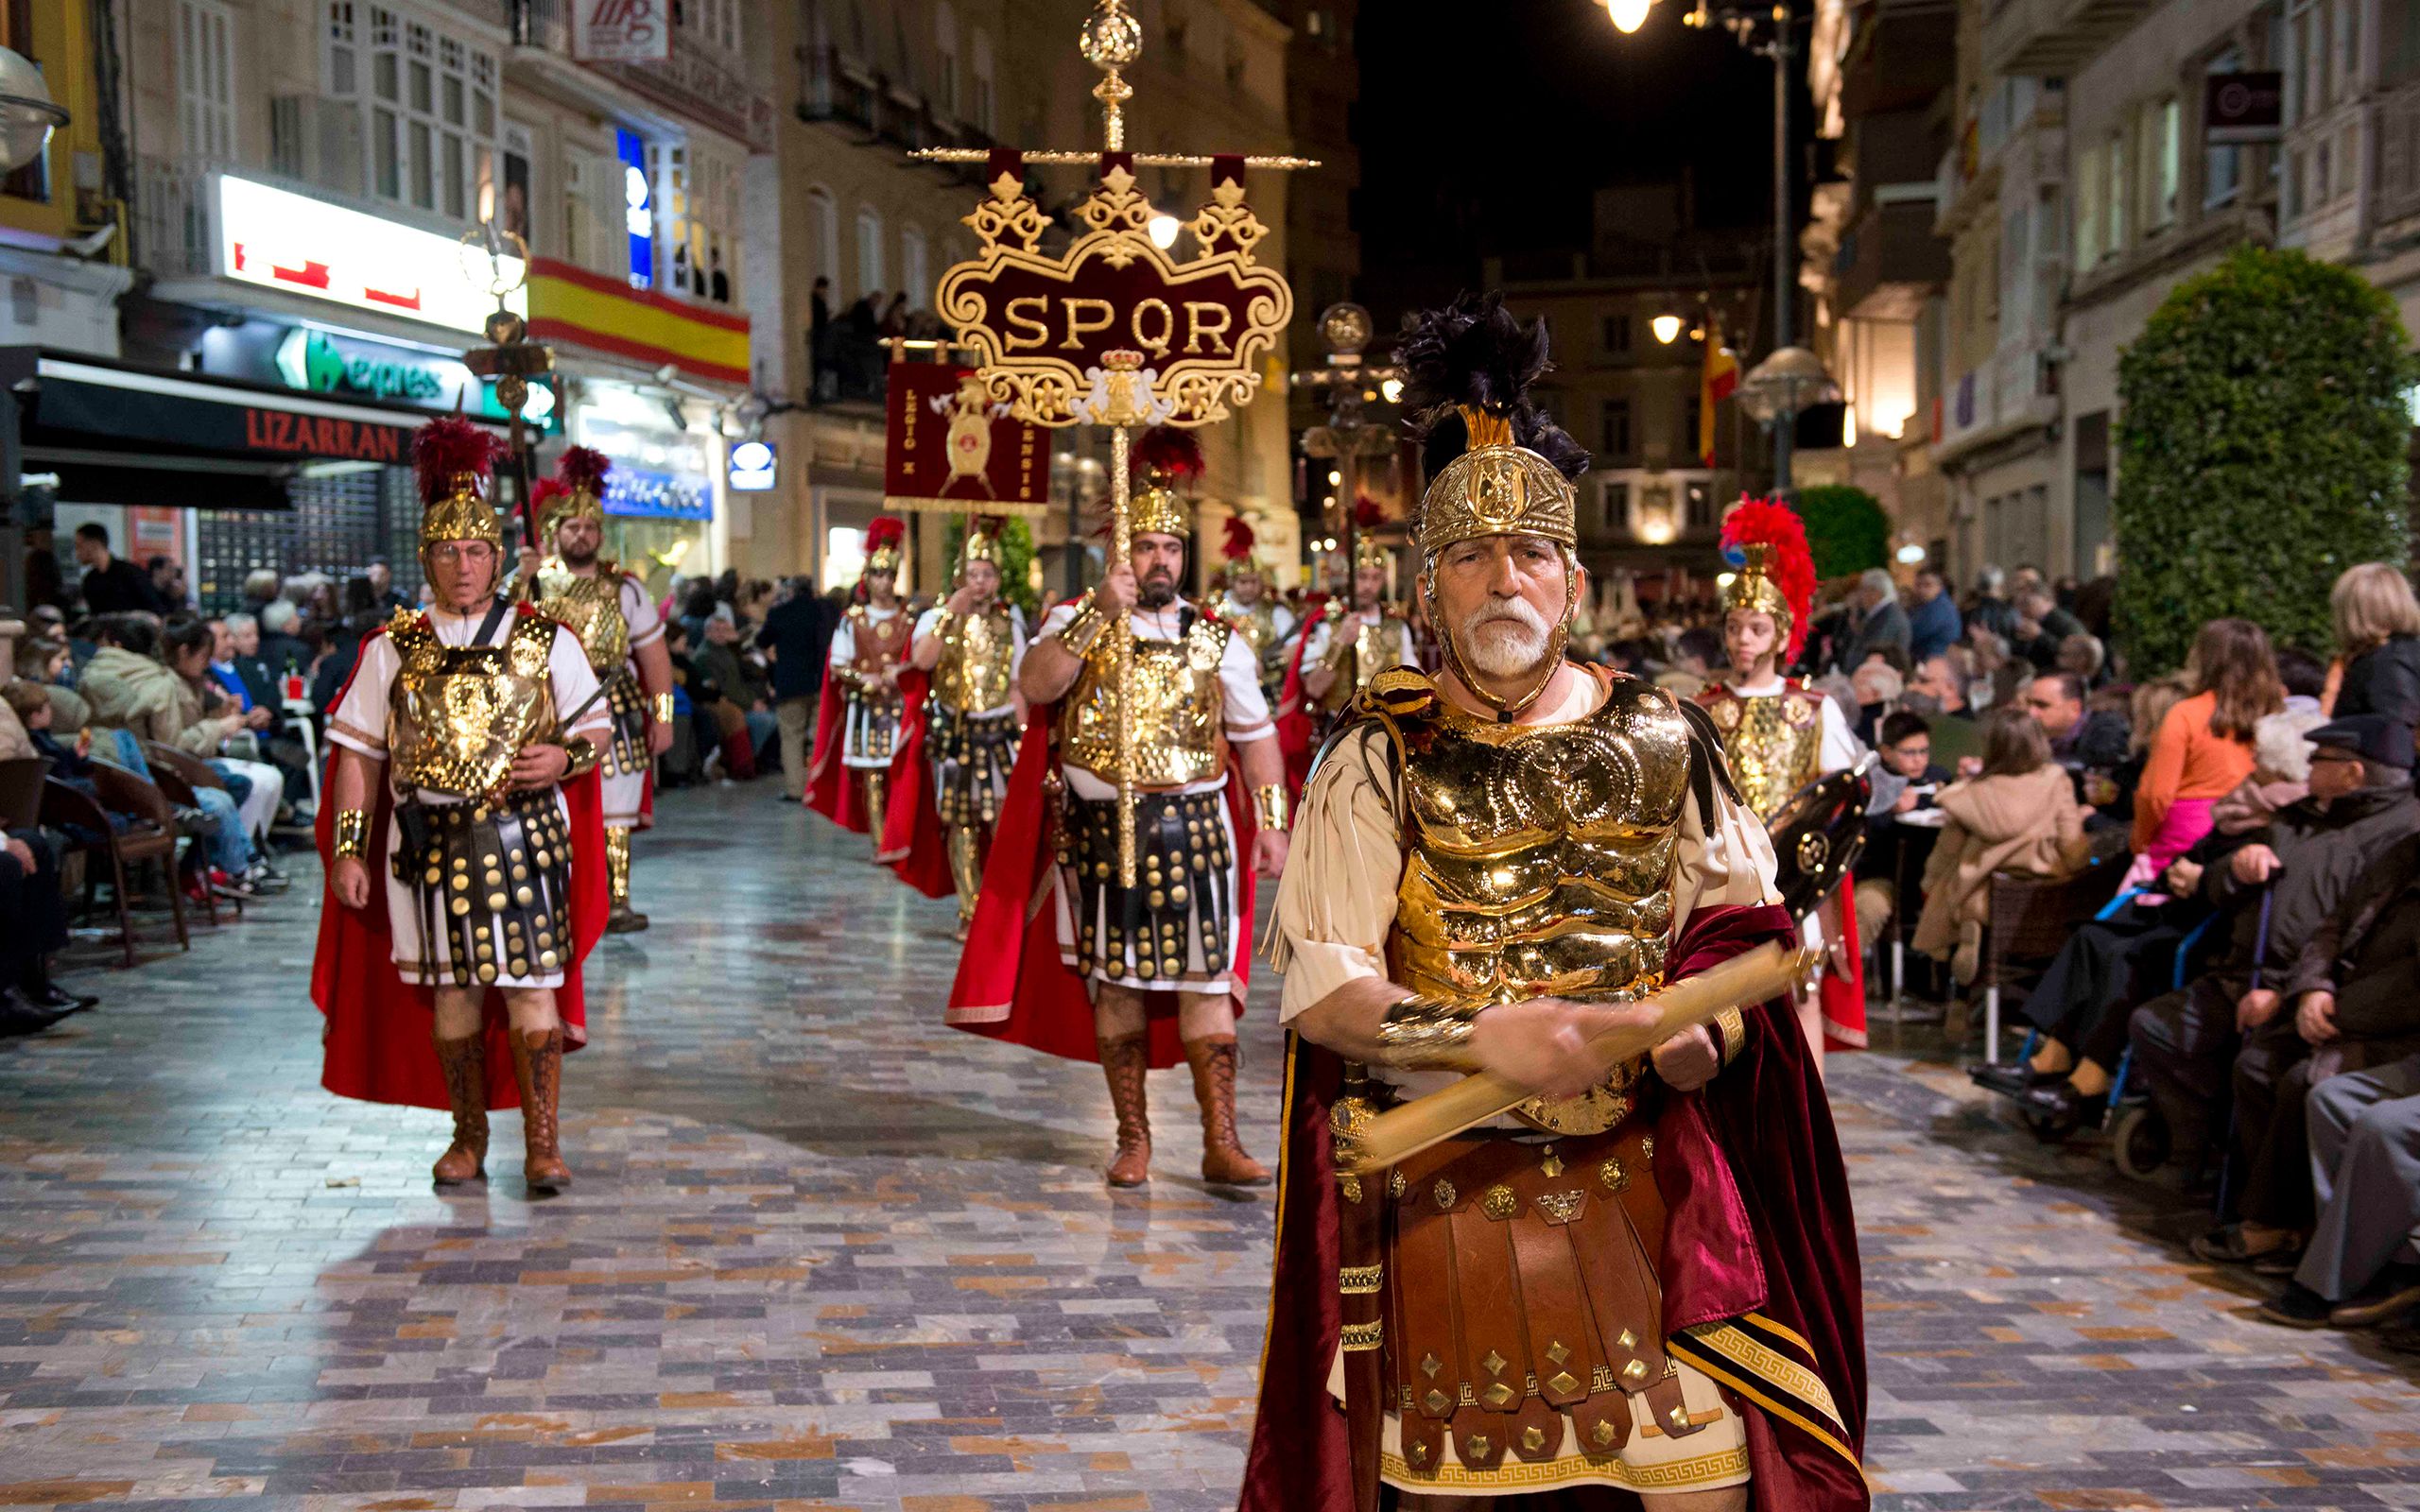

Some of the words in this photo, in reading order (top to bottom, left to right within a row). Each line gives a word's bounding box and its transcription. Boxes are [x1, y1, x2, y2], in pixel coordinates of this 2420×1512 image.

[1004, 294, 1233, 360] SPQR
[246, 407, 400, 463] LIZARRAN
[904, 388, 918, 451] LEGIO
[1019, 421, 1035, 500] ENSIS
